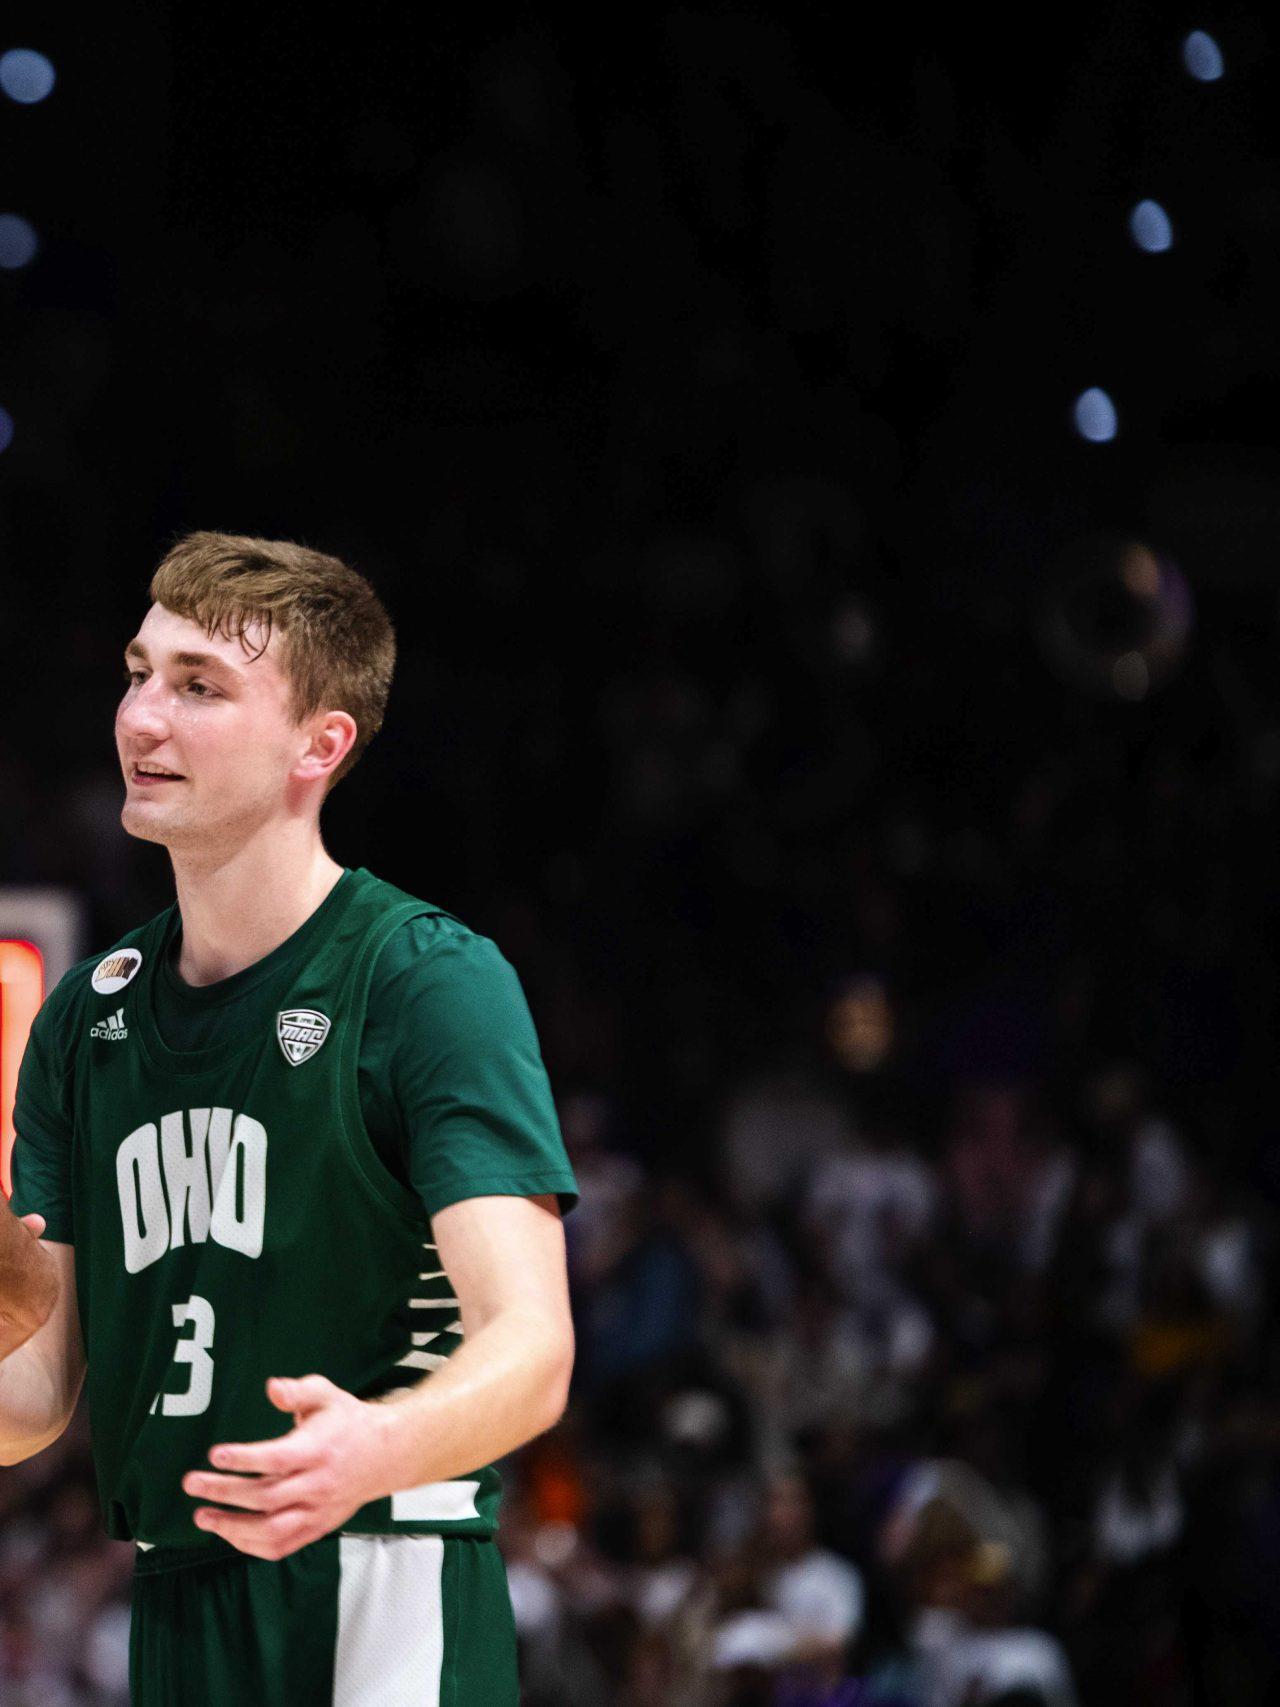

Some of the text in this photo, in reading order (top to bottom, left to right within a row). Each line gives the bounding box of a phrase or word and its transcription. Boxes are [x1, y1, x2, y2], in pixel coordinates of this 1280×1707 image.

[91, 1028, 128, 1041] adidas
[280, 1024, 324, 1045] MAC
[116, 1107, 268, 1274] OHIO
[149, 1295, 215, 1416] 3
